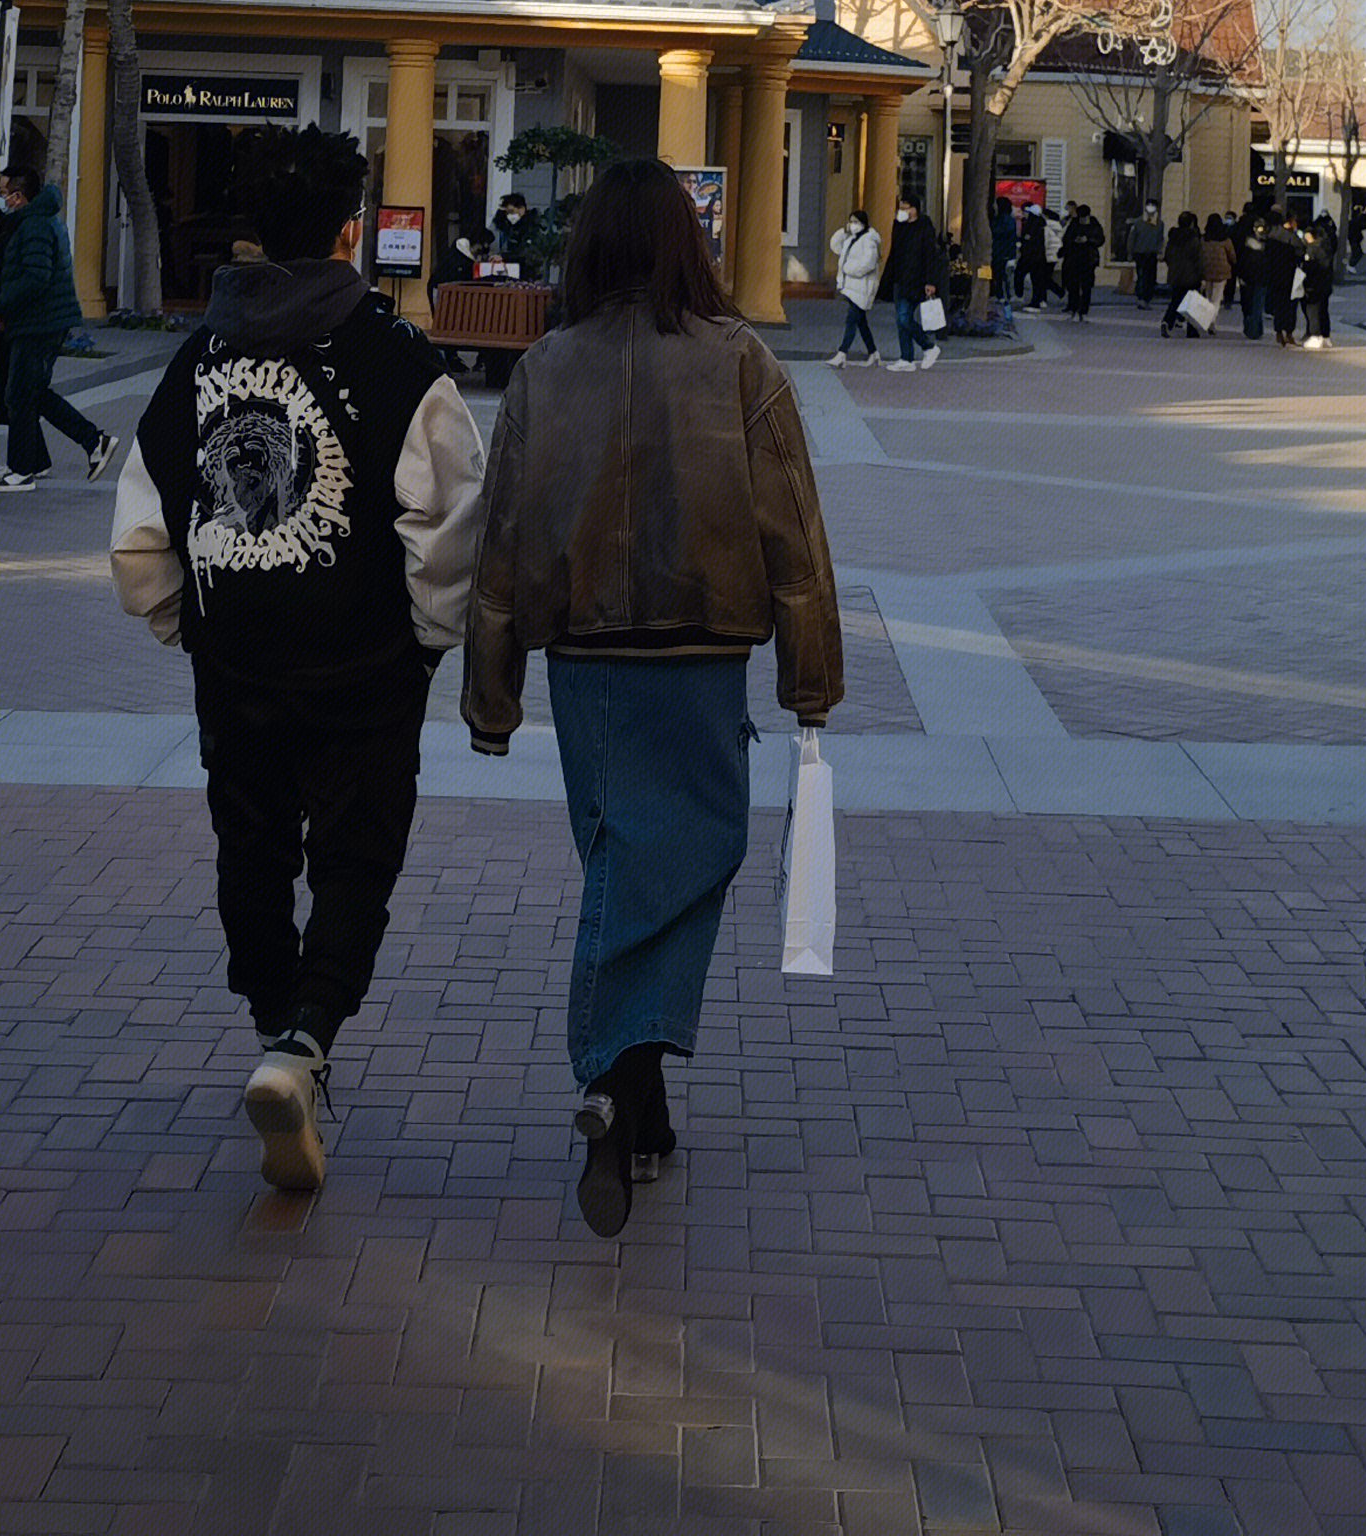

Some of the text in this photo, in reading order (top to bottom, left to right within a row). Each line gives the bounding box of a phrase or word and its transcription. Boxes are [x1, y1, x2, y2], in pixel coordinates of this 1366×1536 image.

[147, 88, 296, 110] POLO RALPH LAUREN
[1257, 175, 1311, 187] CAALI
